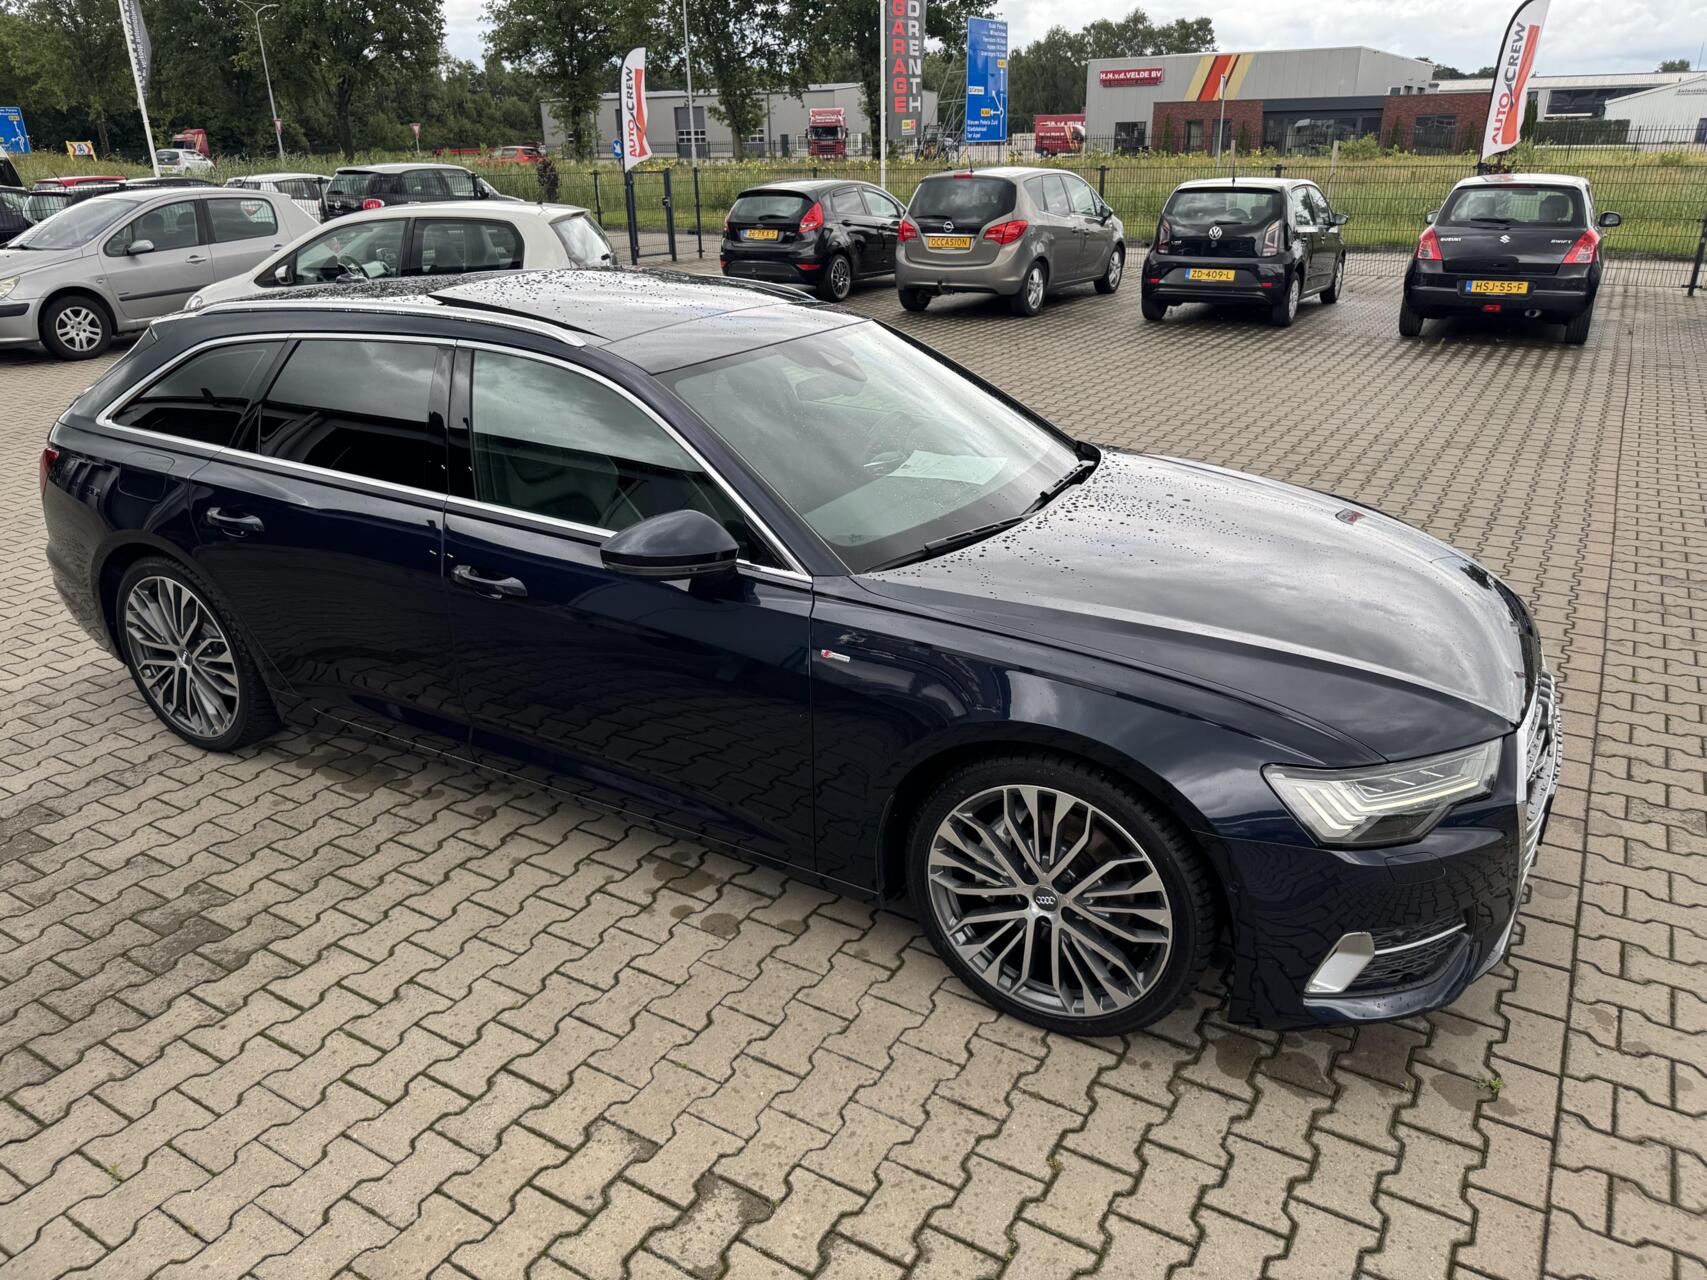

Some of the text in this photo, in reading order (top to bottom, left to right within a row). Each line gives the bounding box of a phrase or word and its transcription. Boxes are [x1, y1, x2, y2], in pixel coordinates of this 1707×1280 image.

[892, 0, 907, 113] GARAGE
[907, 1, 921, 113] DRENTH
[1504, 22, 1526, 82] CREW
[1151, 70, 1162, 78] BV
[625, 66, 638, 158] AUTO CREW
[931, 238, 968, 247] OCCASION
[1191, 269, 1231, 280] ZD-409-L
[1475, 282, 1524, 292] HSJ-55-F
